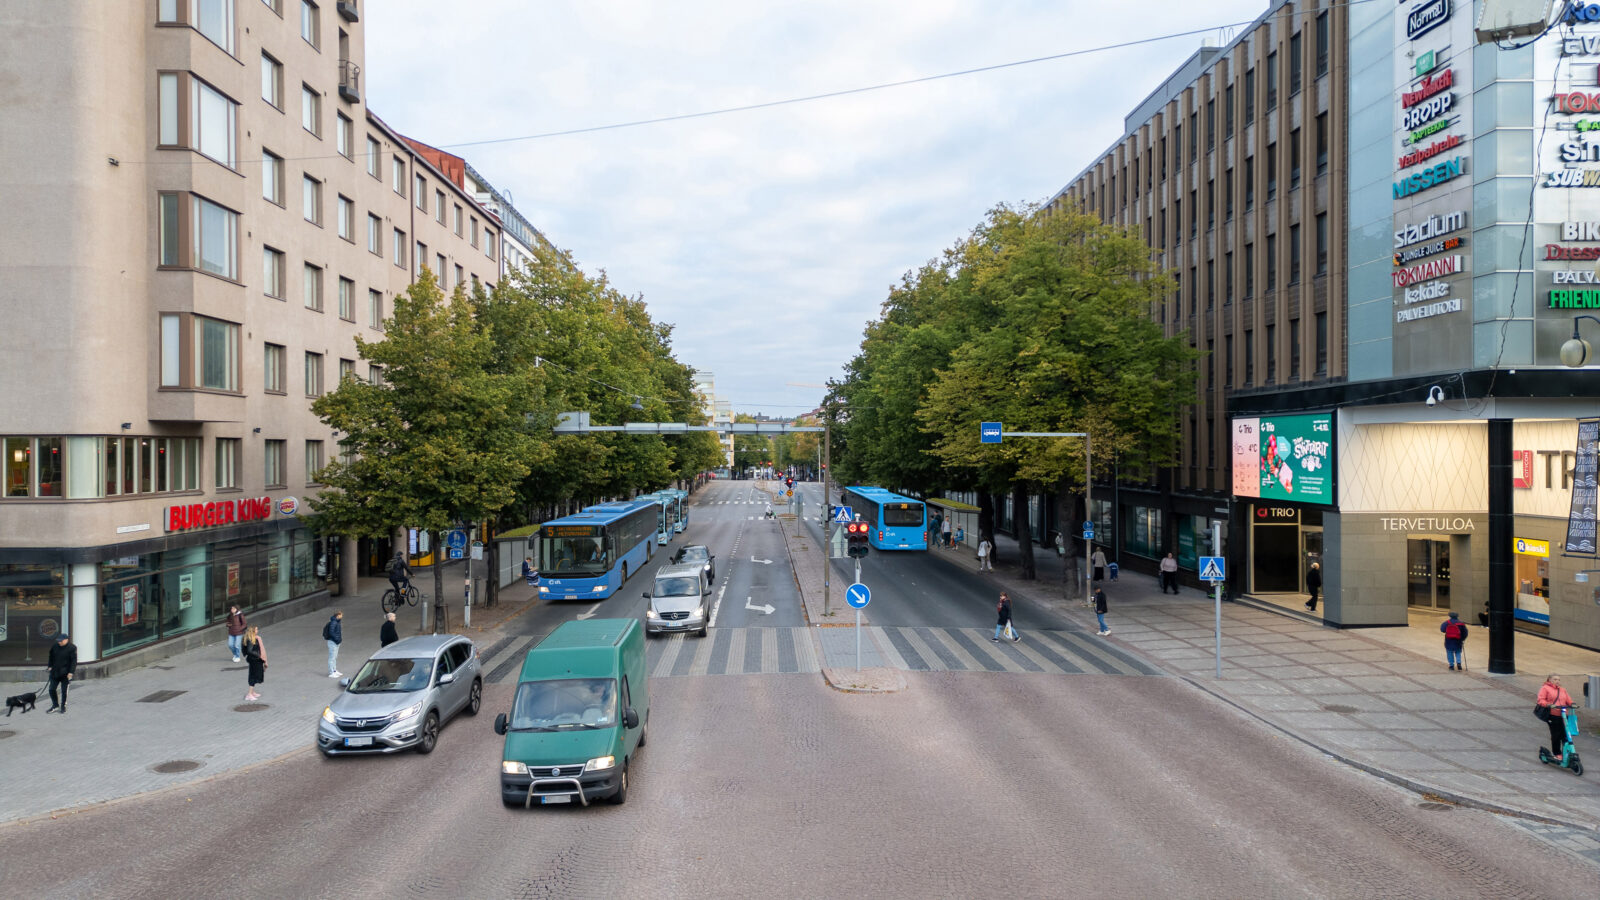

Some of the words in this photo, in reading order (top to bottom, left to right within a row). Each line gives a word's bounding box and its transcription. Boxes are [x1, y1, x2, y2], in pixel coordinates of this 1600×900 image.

[1410, 1, 1443, 33] Normal
[1402, 93, 1452, 131] CROPP
[1393, 156, 1460, 200] NISSEN
[1394, 210, 1464, 248] stadium
[1402, 247, 1426, 262] JUNGLE
[1426, 239, 1445, 255] JUICE
[1445, 236, 1459, 250] BAR
[1392, 255, 1457, 288] TOKMANNI
[1398, 298, 1461, 323] PALVELUTORI
[170, 501, 234, 531] BURGER
[237, 496, 271, 522] KING
[1270, 507, 1295, 517] TRIO
[1380, 517, 1475, 530] TERVETULOA
